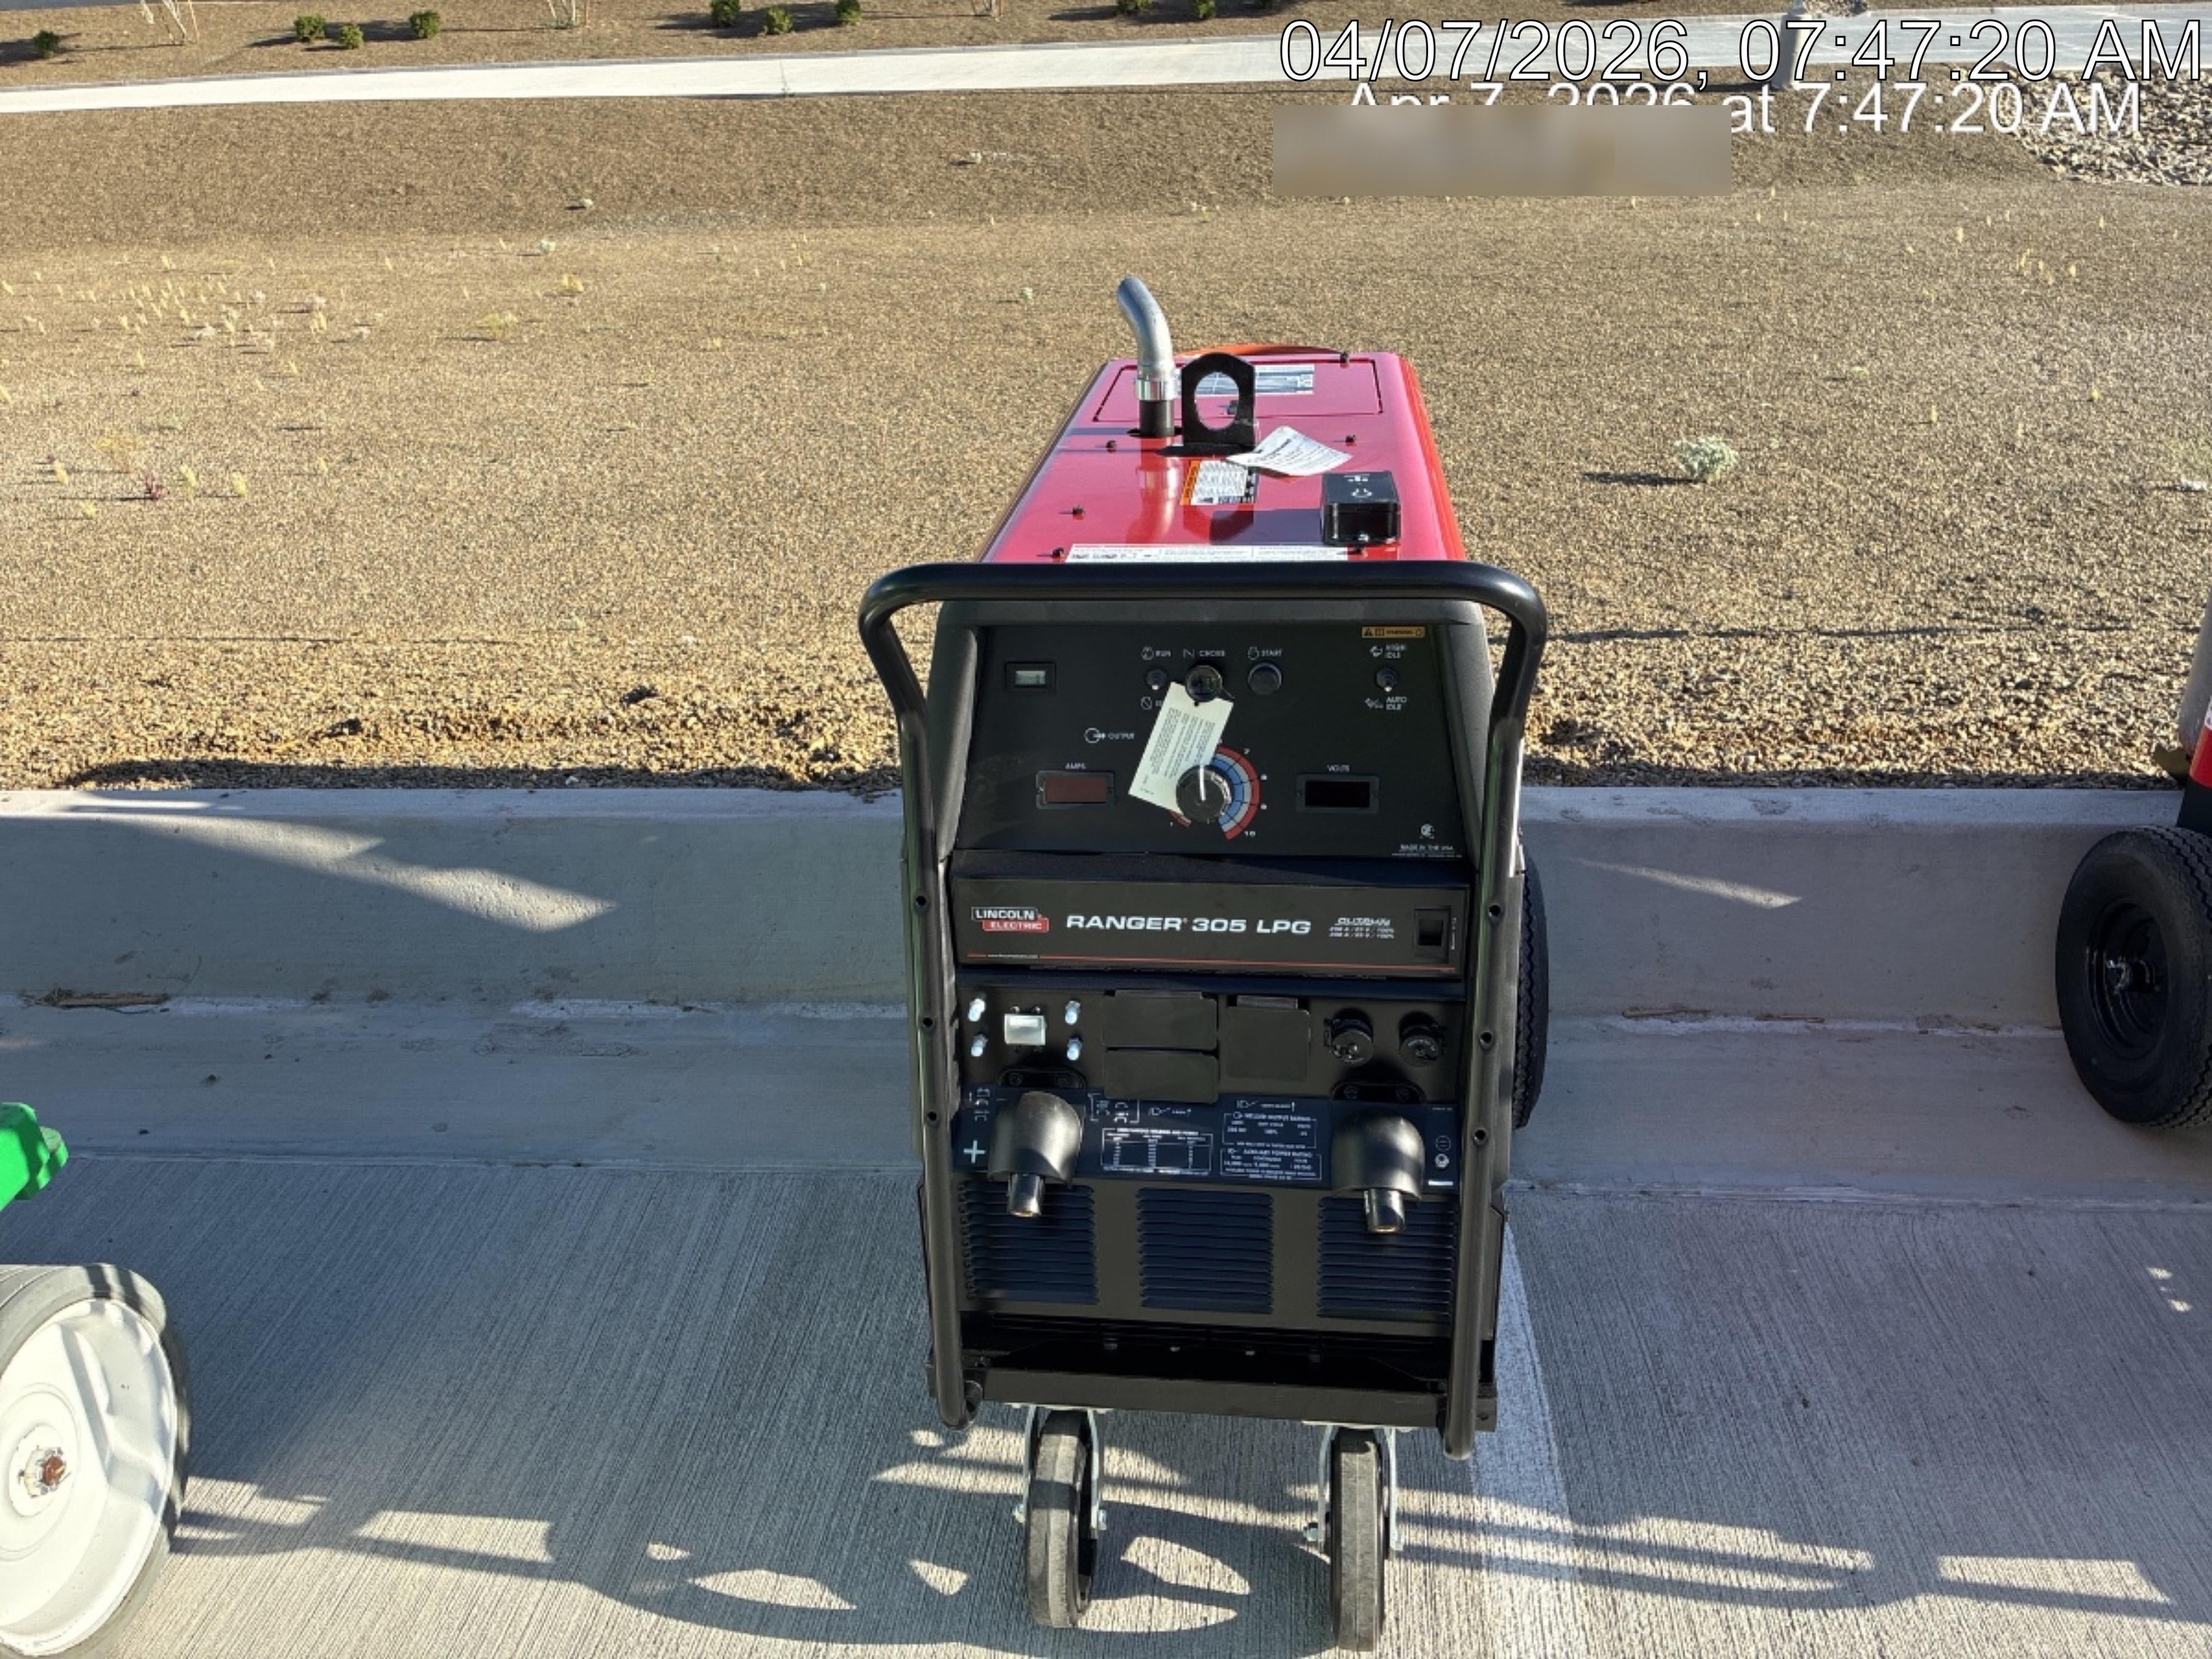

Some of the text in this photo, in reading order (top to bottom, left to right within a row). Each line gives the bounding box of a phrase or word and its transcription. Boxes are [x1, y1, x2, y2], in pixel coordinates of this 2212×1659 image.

[975, 910, 1035, 920] LINCOLN
[1191, 917, 1247, 931] 305
[1256, 919, 1311, 934] LPG
